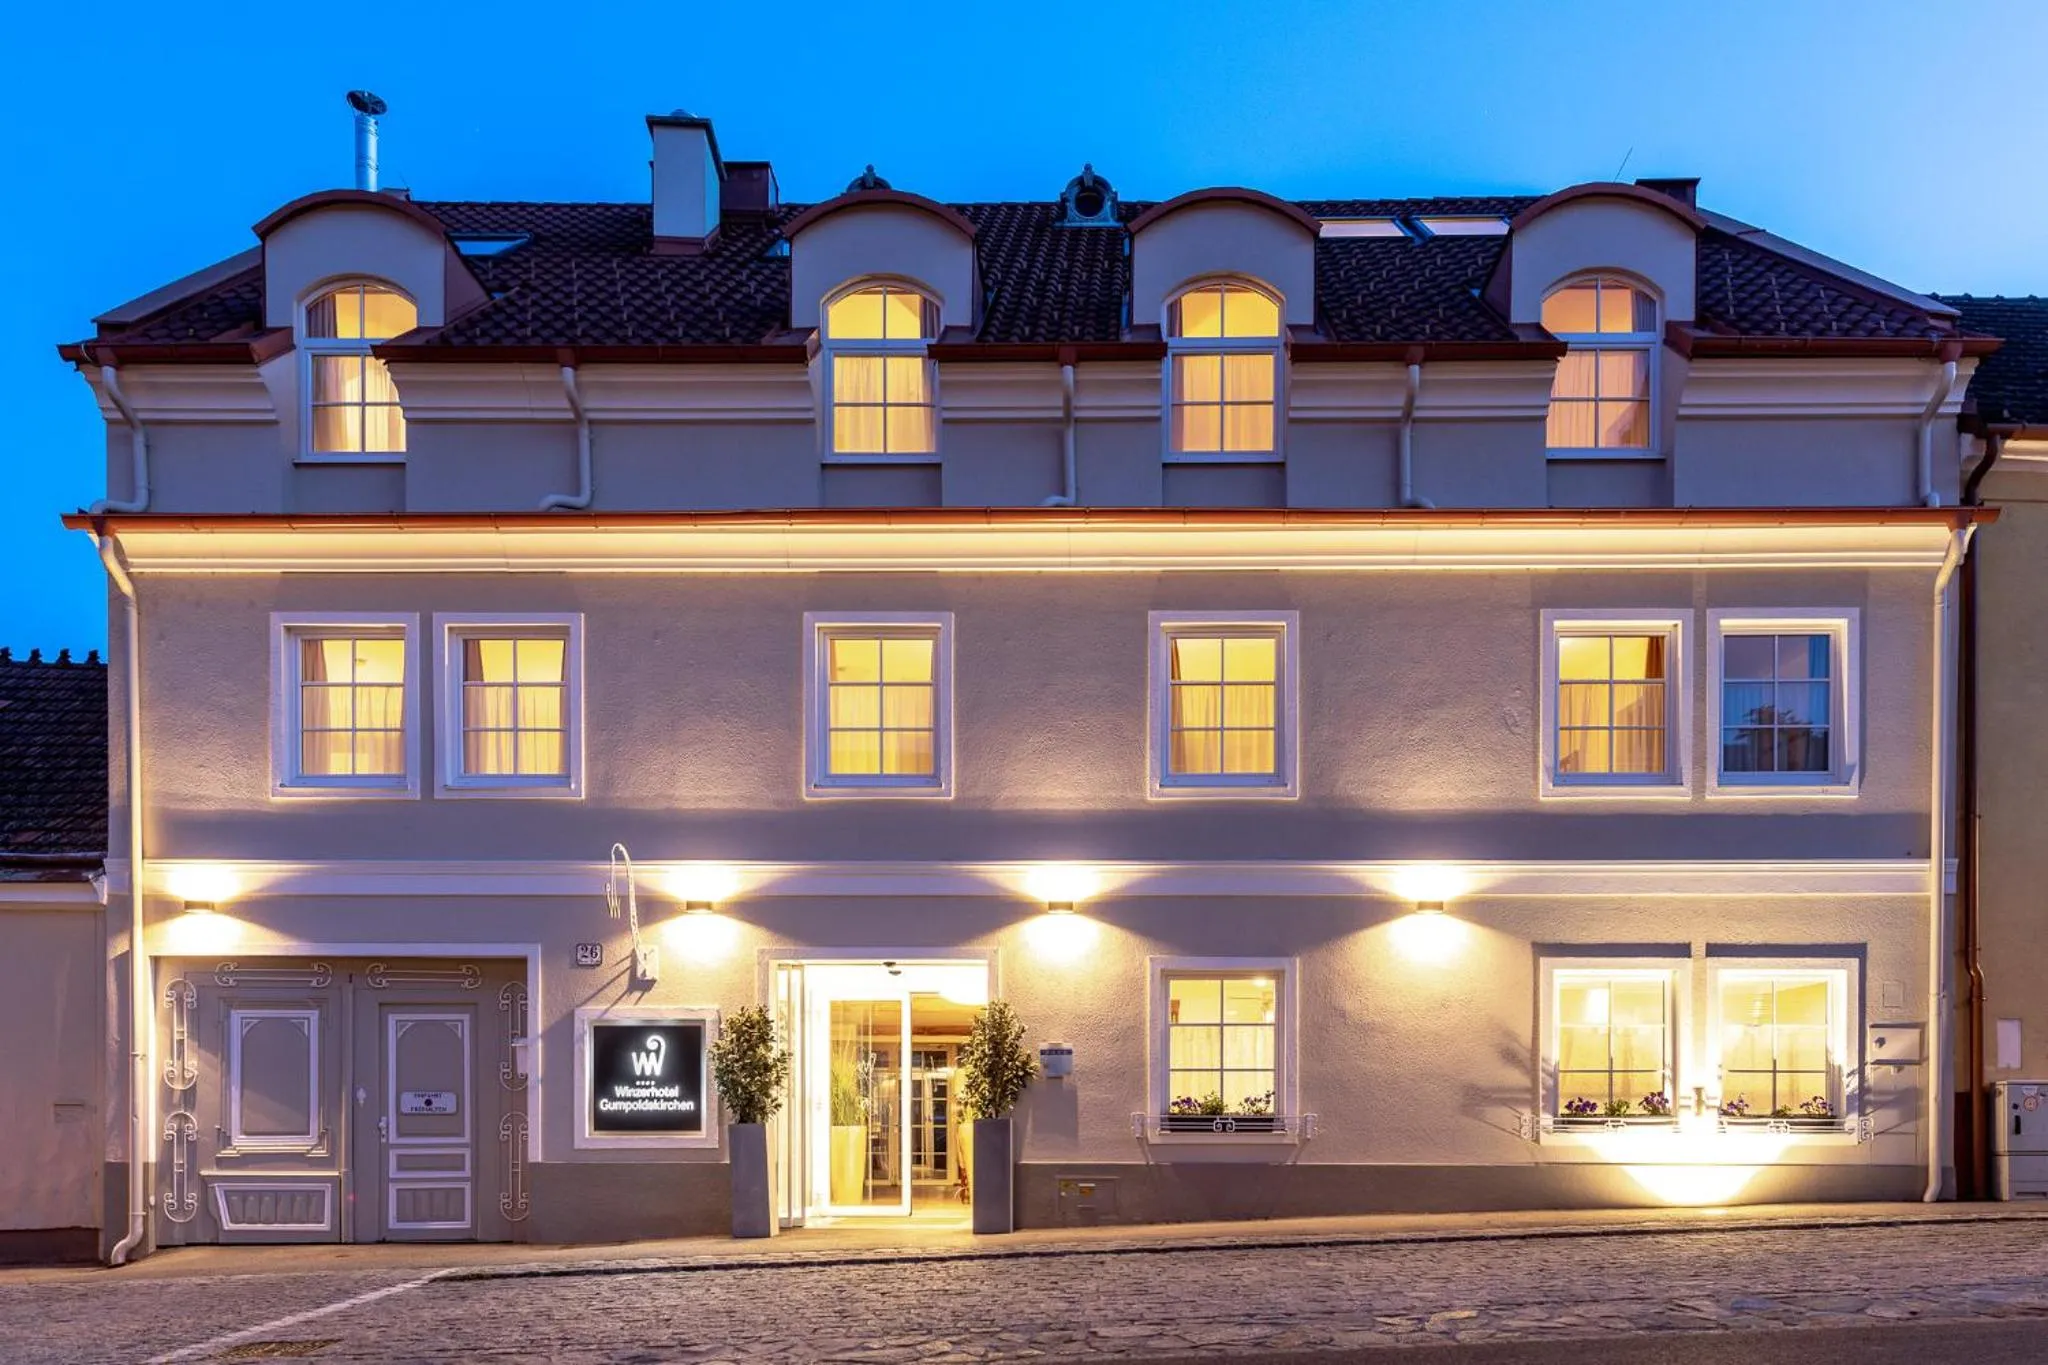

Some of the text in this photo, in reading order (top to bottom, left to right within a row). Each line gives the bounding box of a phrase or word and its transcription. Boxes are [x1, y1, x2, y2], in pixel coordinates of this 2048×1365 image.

[581, 945, 599, 959] 26
[614, 1085, 680, 1098] Winzerhotel
[599, 1098, 695, 1113] Gumpoldskirchen
